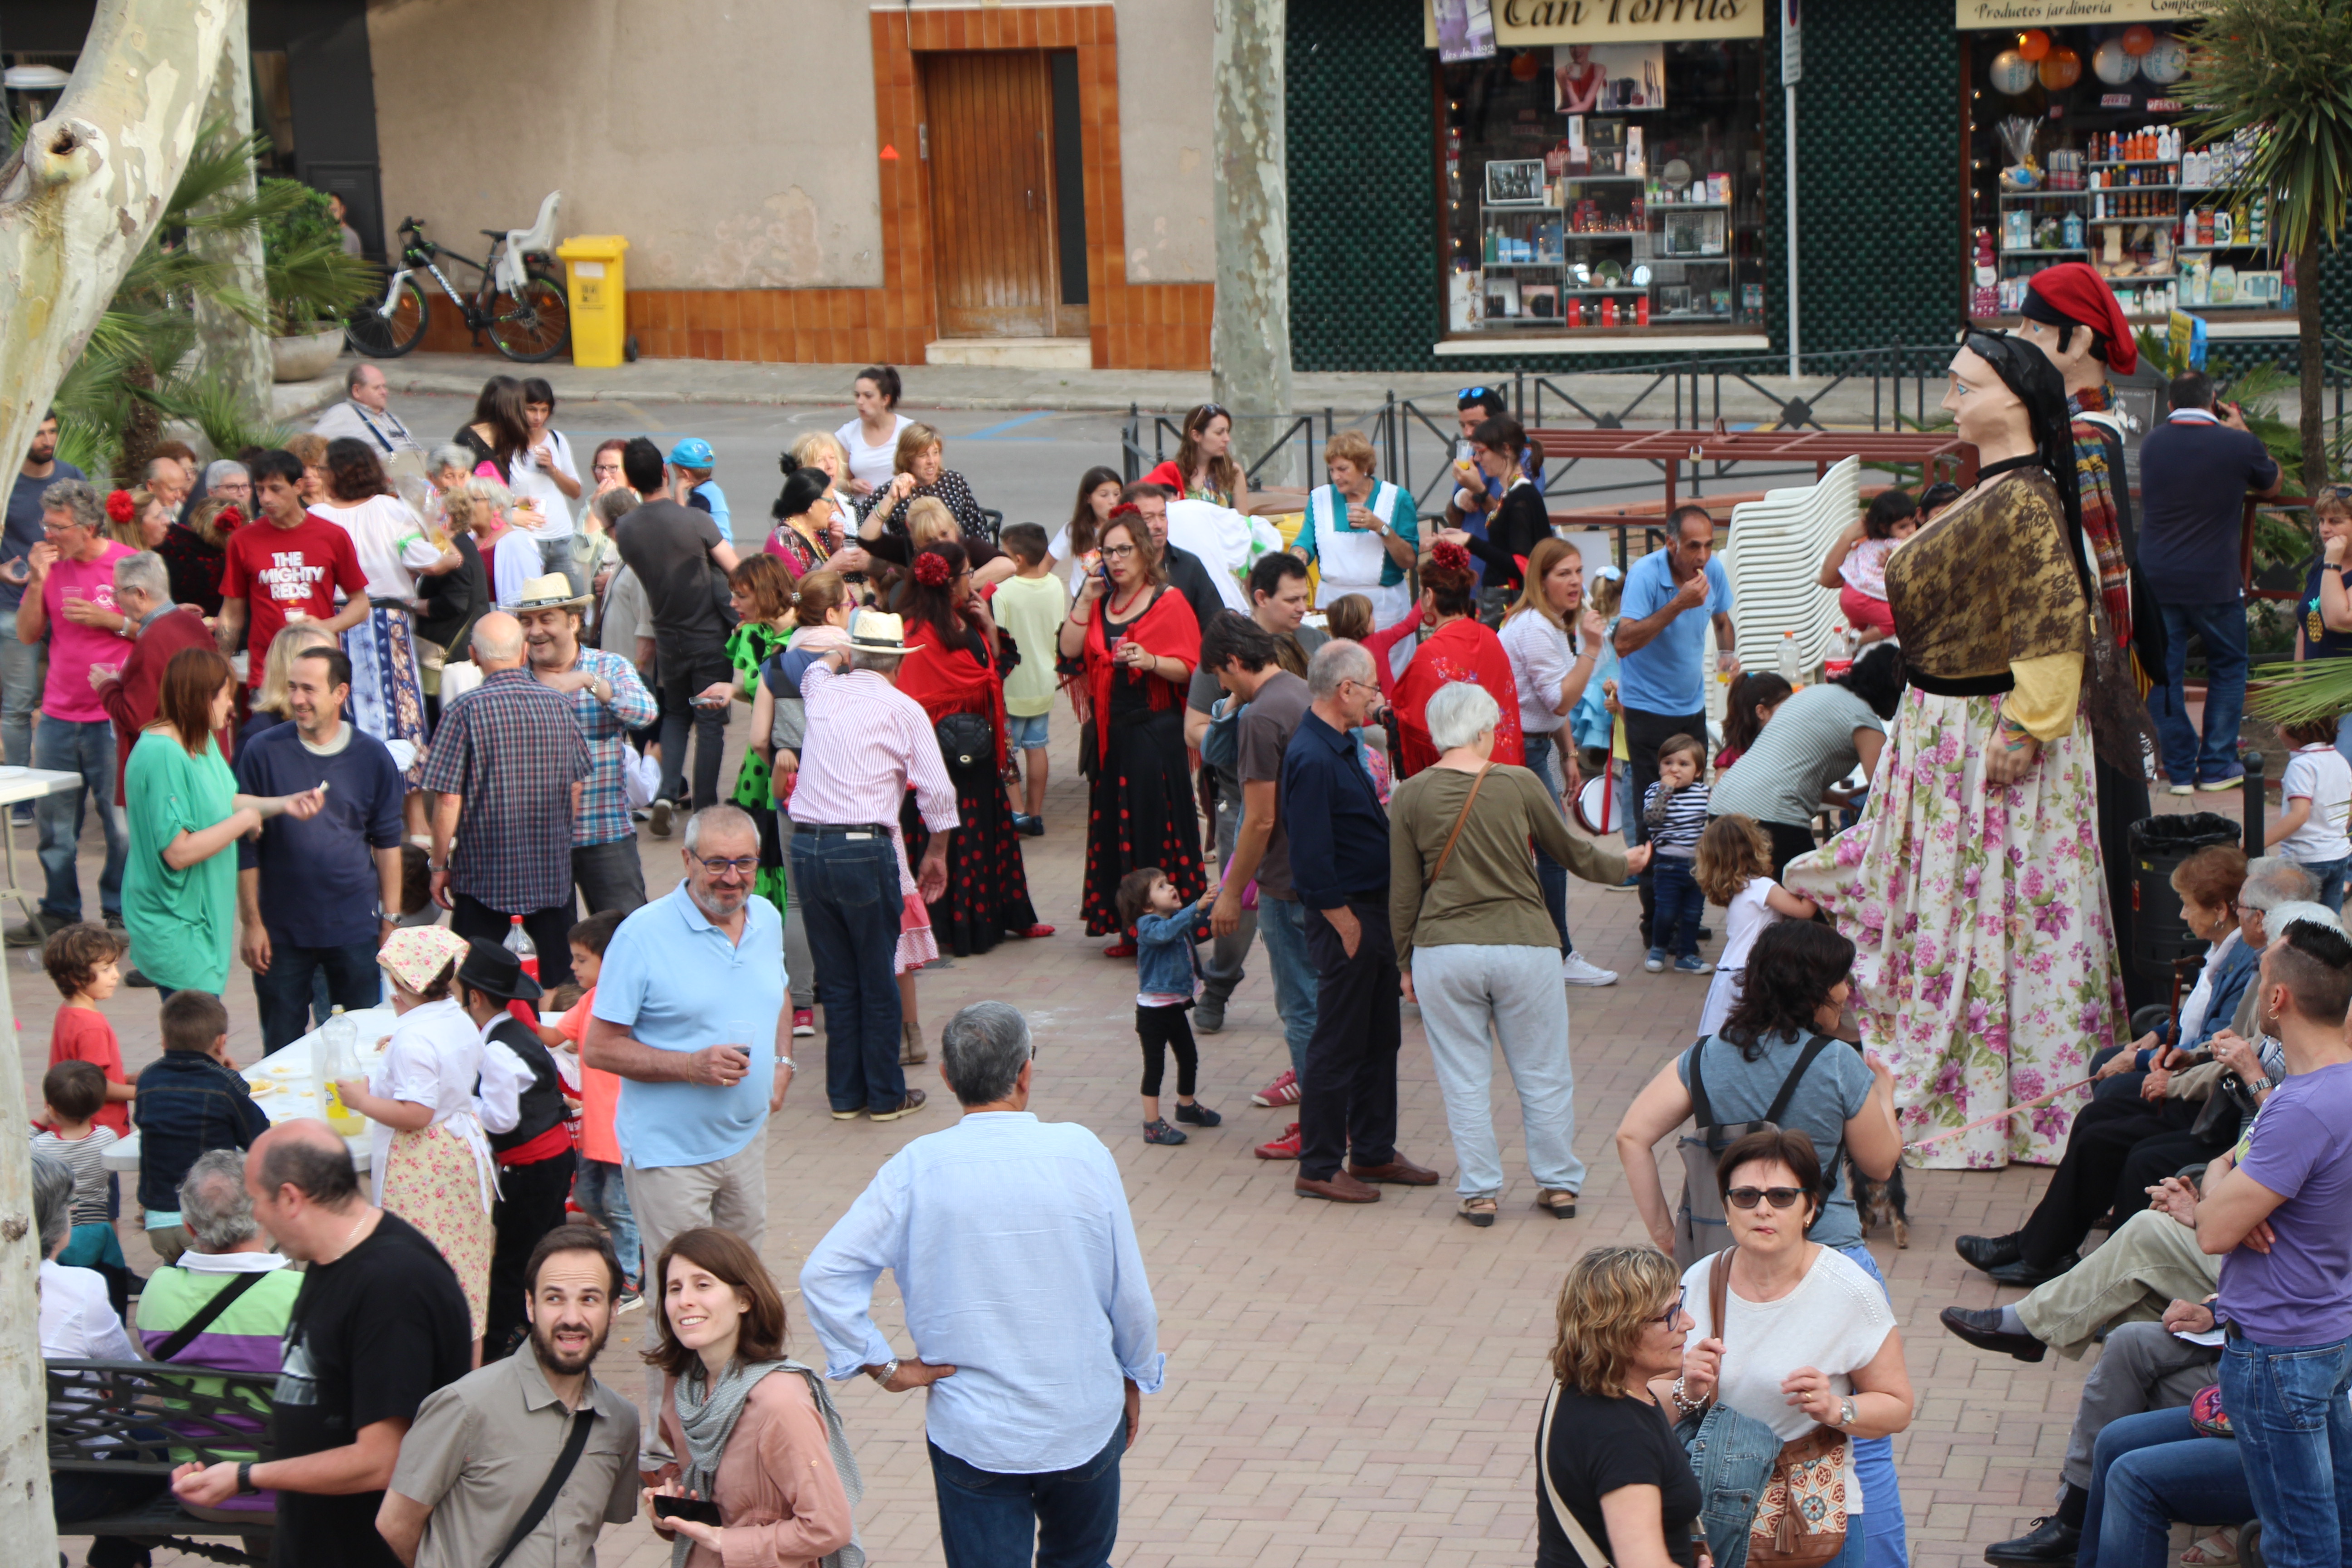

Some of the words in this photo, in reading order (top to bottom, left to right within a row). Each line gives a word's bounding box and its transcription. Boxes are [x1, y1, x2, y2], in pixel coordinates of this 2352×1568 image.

[1975, 1, 2041, 19] Productes
[2046, 0, 2112, 20] jardineria
[271, 551, 304, 567] THE
[259, 566, 325, 584] MIGHTY
[270, 582, 313, 601] REDS
